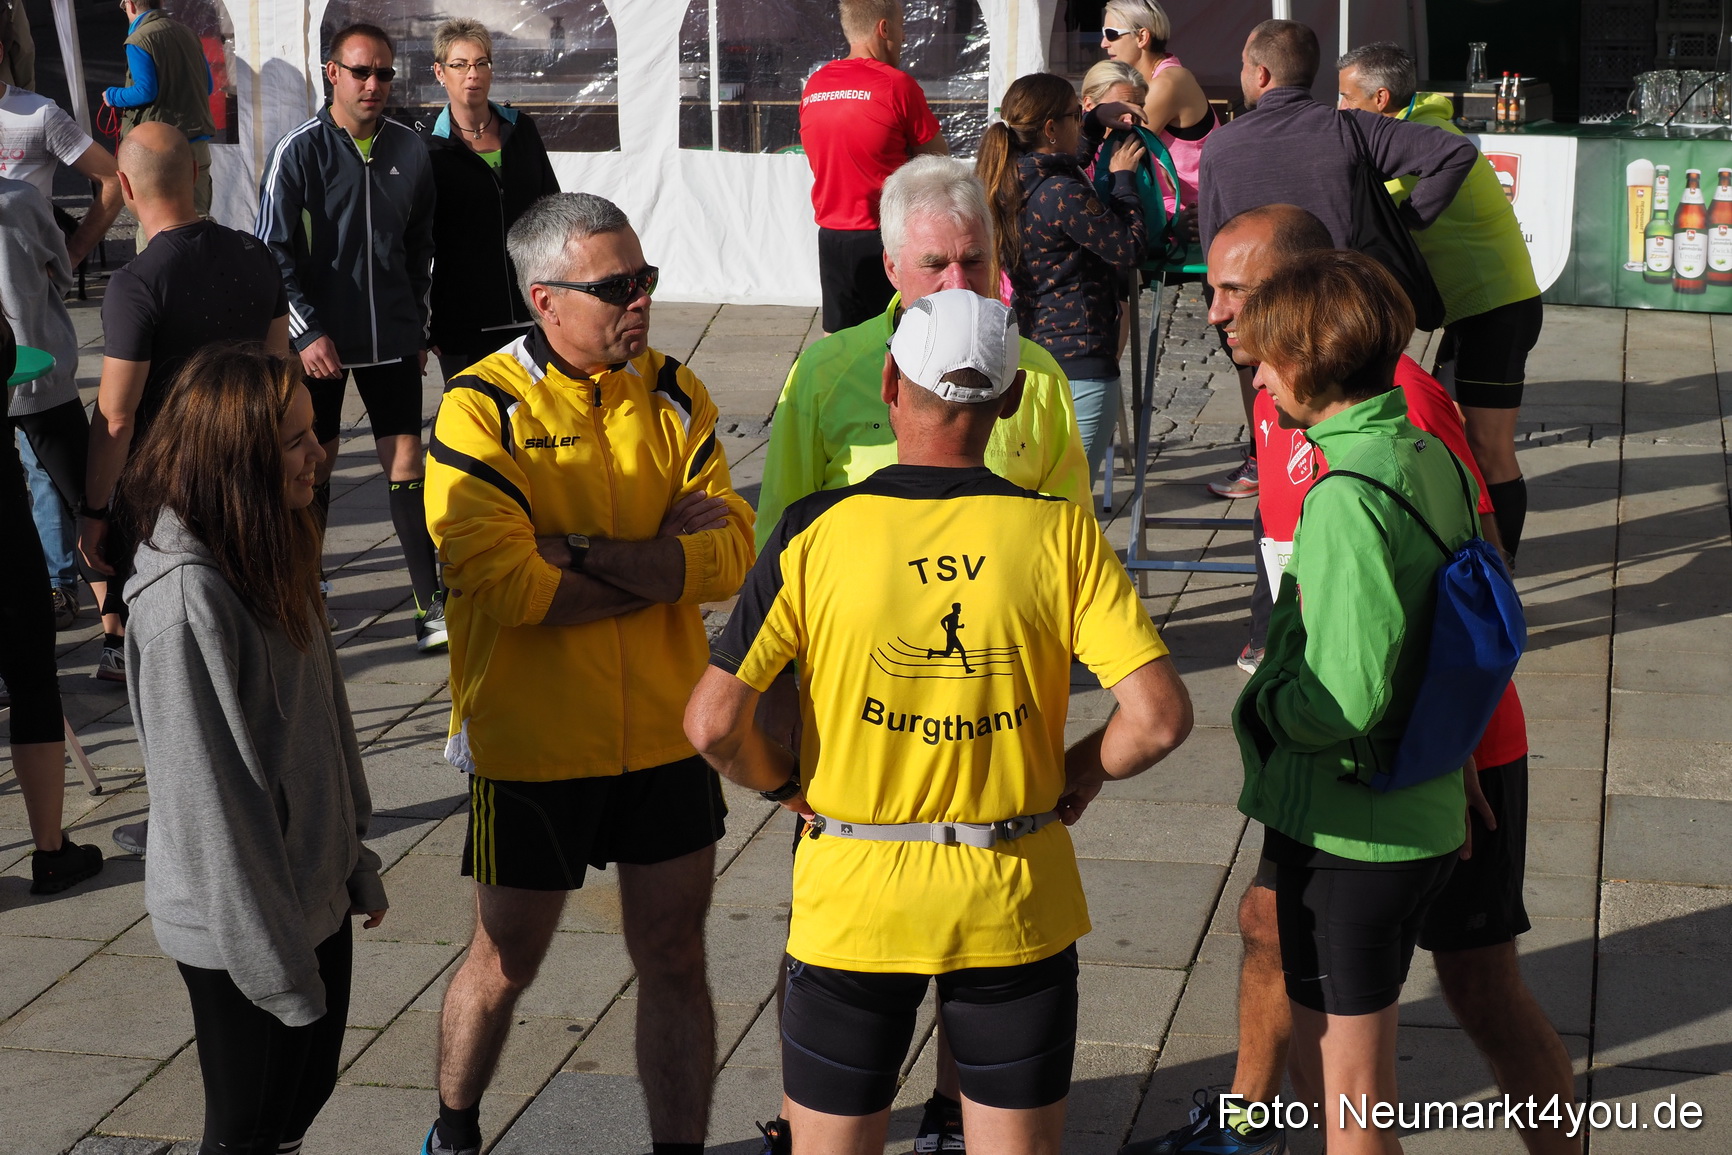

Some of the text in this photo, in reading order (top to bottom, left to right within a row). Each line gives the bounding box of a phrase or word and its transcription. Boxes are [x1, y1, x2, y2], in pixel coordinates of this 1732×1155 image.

[809, 90, 871, 103] OBERFERRIEDEN
[525, 435, 580, 448] saller
[908, 554, 986, 584] TSV
[861, 697, 1029, 745] Burgthann
